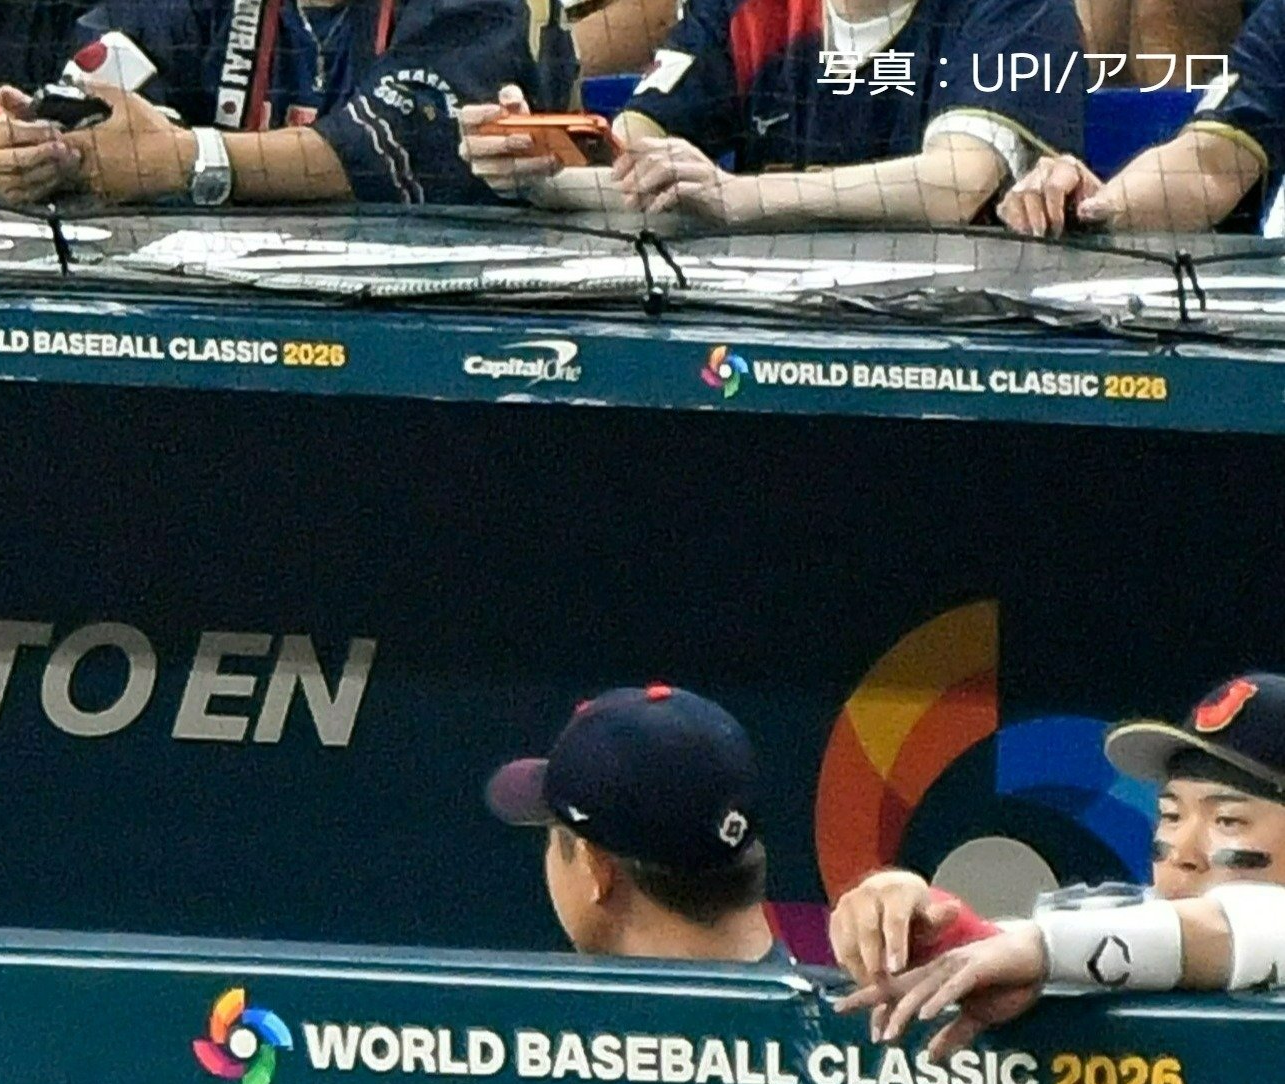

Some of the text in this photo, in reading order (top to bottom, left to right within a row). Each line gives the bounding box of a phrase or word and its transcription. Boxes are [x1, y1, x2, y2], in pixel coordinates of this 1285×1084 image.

[33, 332, 165, 359] BASEBALL
[169, 338, 278, 364] CLASSIC
[282, 342, 346, 367] 2026
[753, 361, 848, 387] WORLD
[852, 365, 985, 392] BASEBALL
[989, 371, 1099, 397] CLASSIC
[172, 631, 377, 747] EN
[303, 1023, 505, 1075] WORLD
